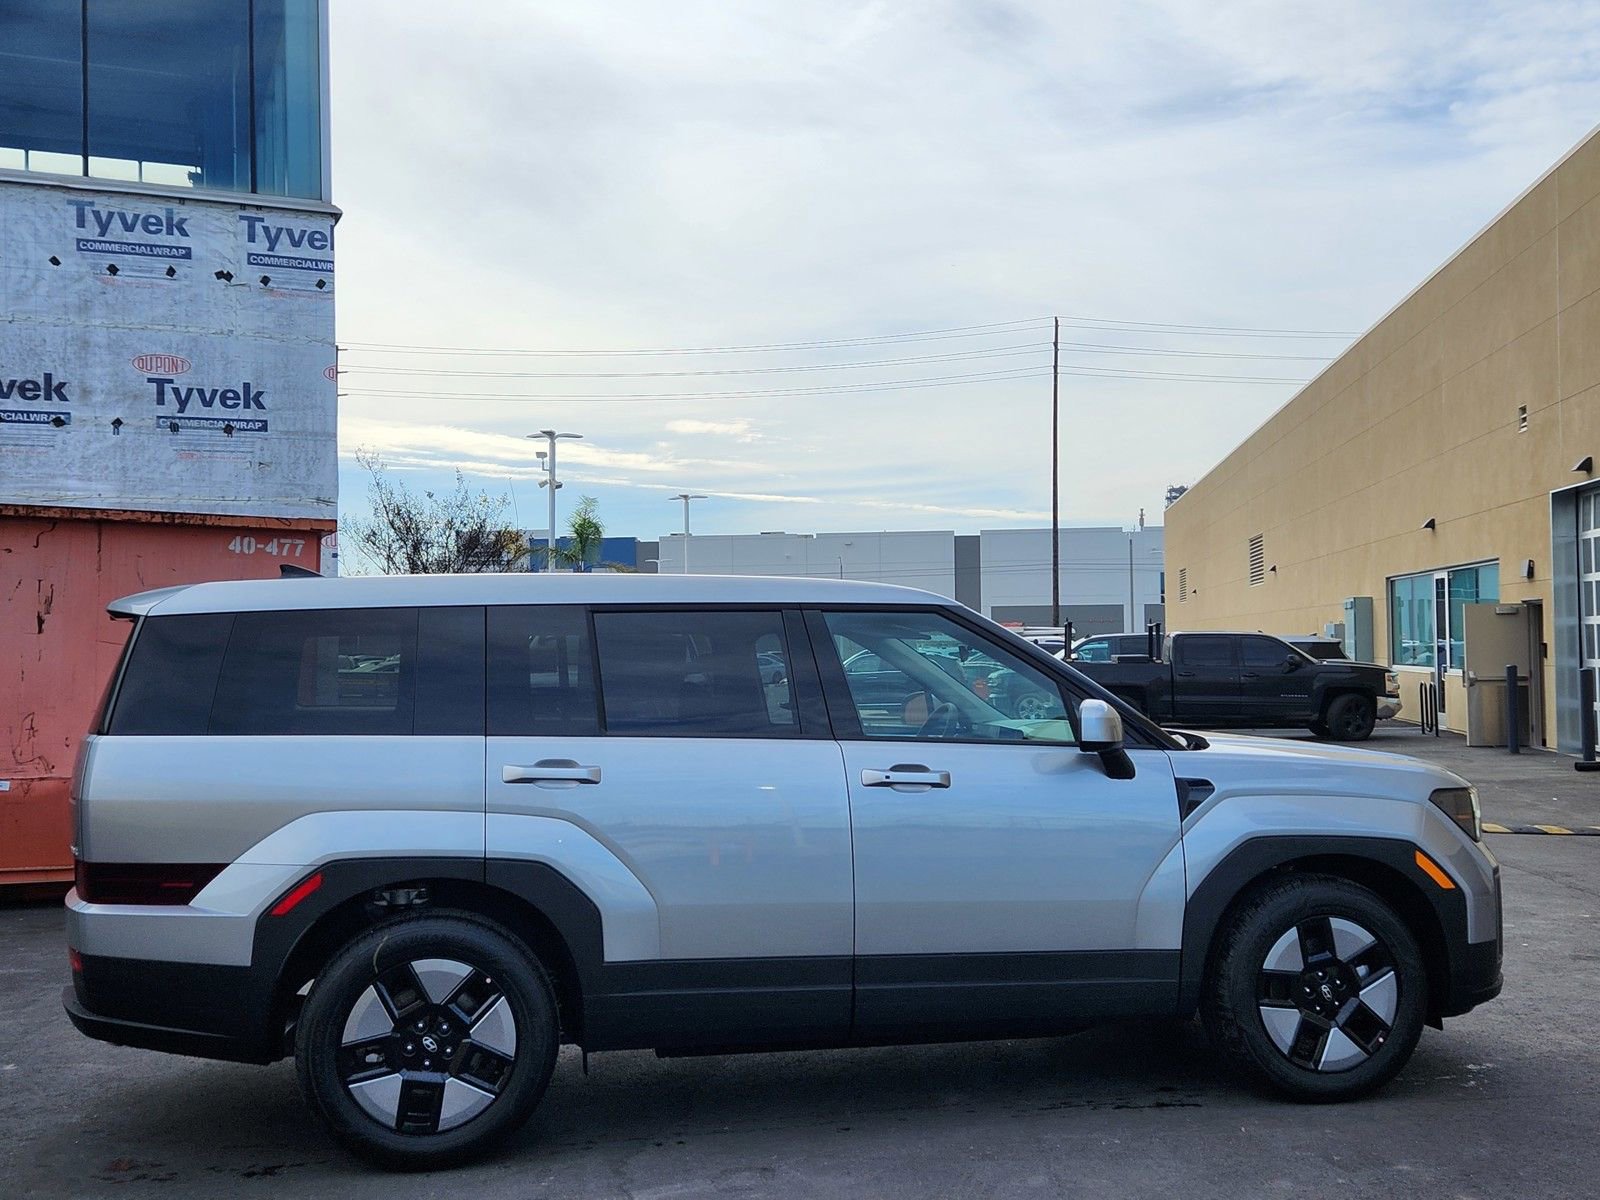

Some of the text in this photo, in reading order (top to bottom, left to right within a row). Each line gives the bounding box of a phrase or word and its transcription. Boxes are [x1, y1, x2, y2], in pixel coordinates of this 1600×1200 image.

[66, 199, 191, 238] Tyvek
[239, 214, 334, 252] Tyve
[146, 377, 267, 414] Tyvek
[227, 535, 305, 558] 40-477
